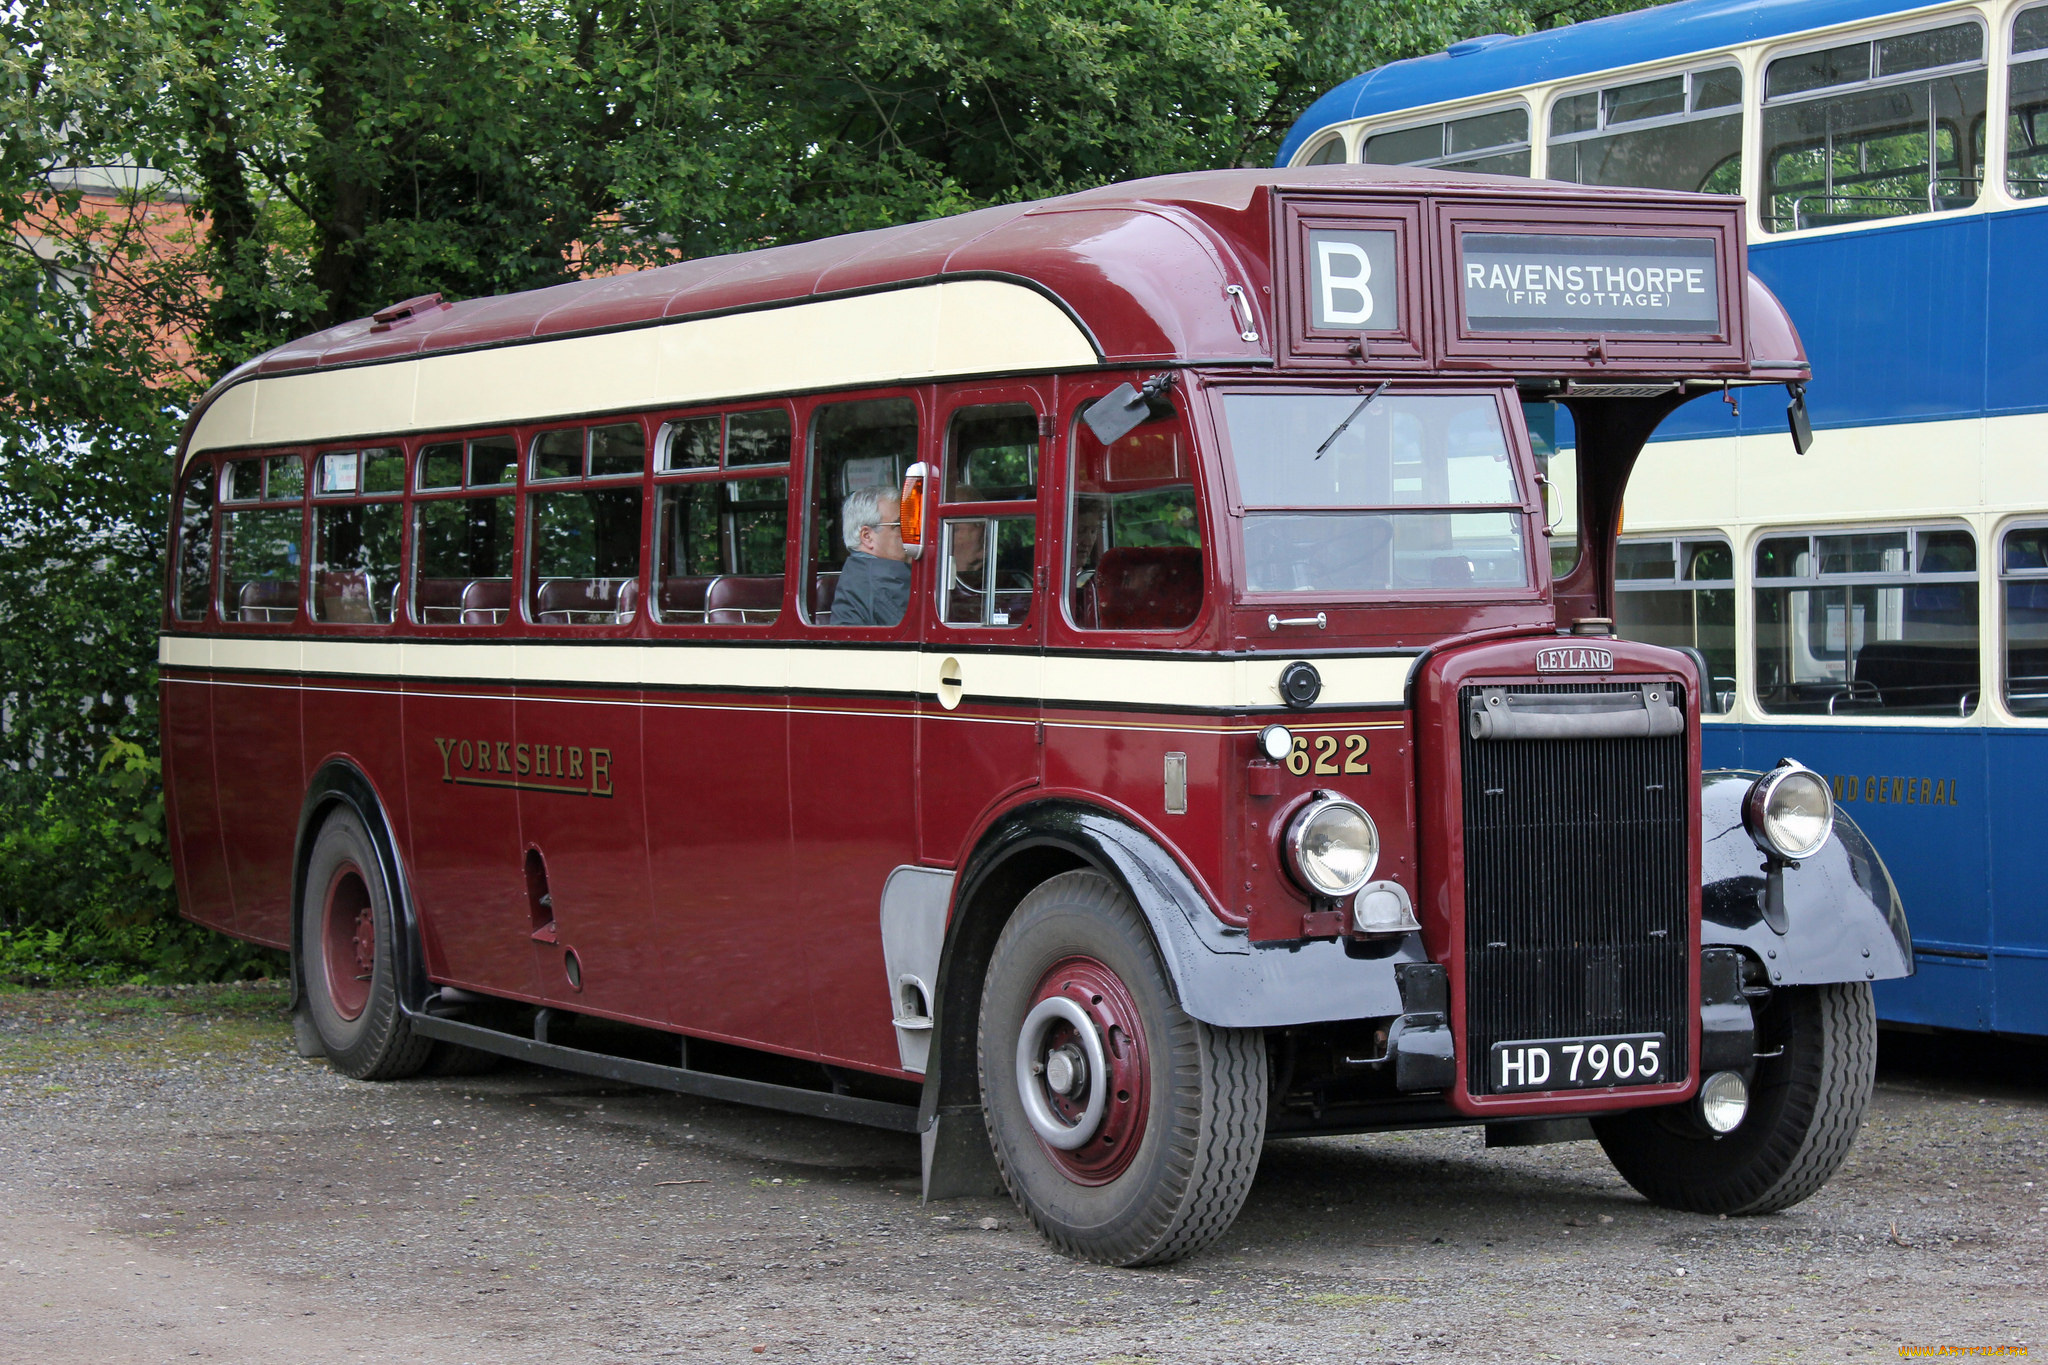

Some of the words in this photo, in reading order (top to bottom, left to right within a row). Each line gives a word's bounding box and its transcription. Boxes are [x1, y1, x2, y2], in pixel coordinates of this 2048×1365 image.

[1317, 240, 1374, 324] B
[1466, 262, 1705, 294] RAVENSTHORPE
[1505, 290, 1547, 305] (FIR
[1565, 292, 1671, 308] COTTAGE)
[1539, 649, 1611, 669] LEYLAND
[434, 737, 614, 798] YORKSHIRE
[1286, 734, 1370, 776] 622
[1823, 775, 1859, 802] ND
[1864, 775, 1958, 806] GENERAL
[1502, 1047, 1551, 1087] HD
[1562, 1041, 1660, 1082] 7905
